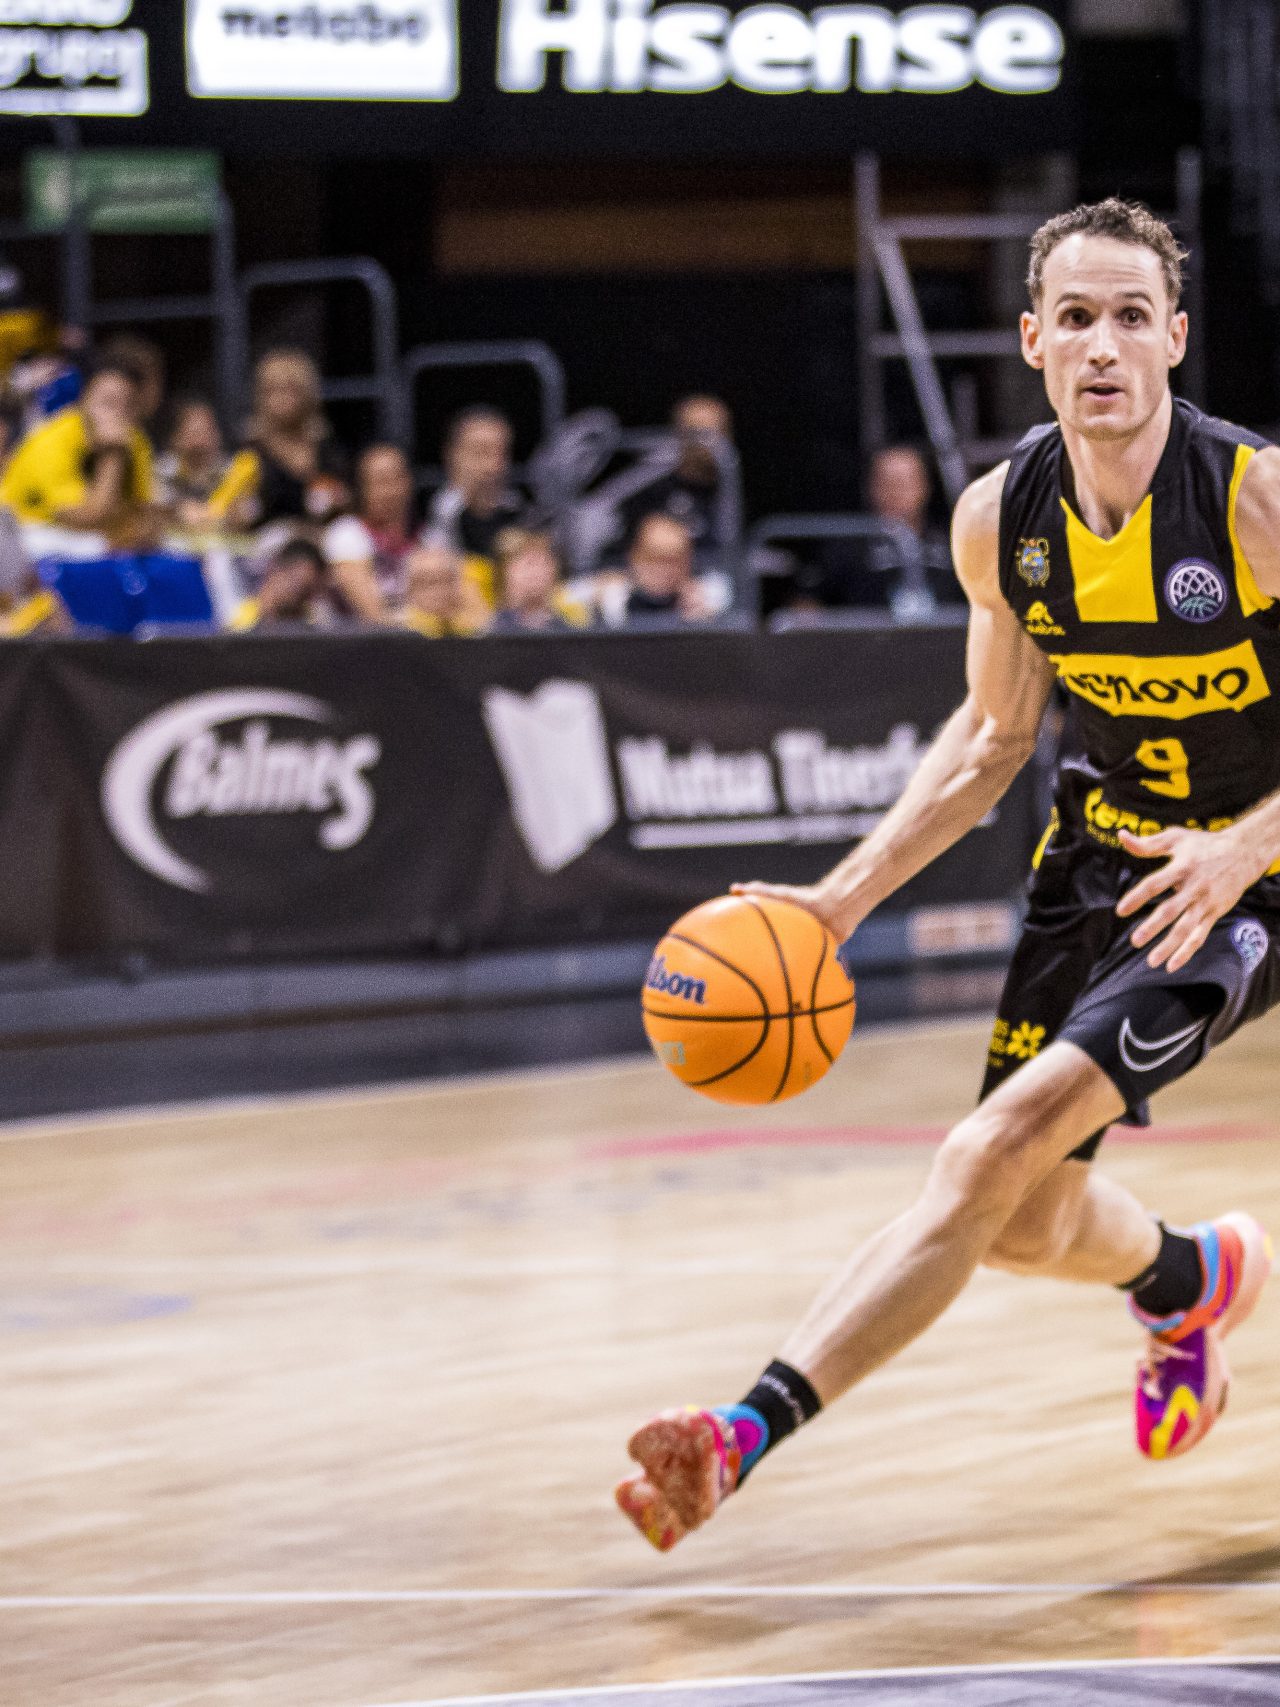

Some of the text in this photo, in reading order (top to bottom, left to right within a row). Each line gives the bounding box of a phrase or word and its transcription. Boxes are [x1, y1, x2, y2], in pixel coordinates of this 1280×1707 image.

[497, 0, 1064, 95] Hisense
[165, 720, 381, 850] Balmes
[618, 728, 935, 817] Mutua Tinerf
[1136, 738, 1191, 799] 9
[647, 954, 707, 1006] lson
